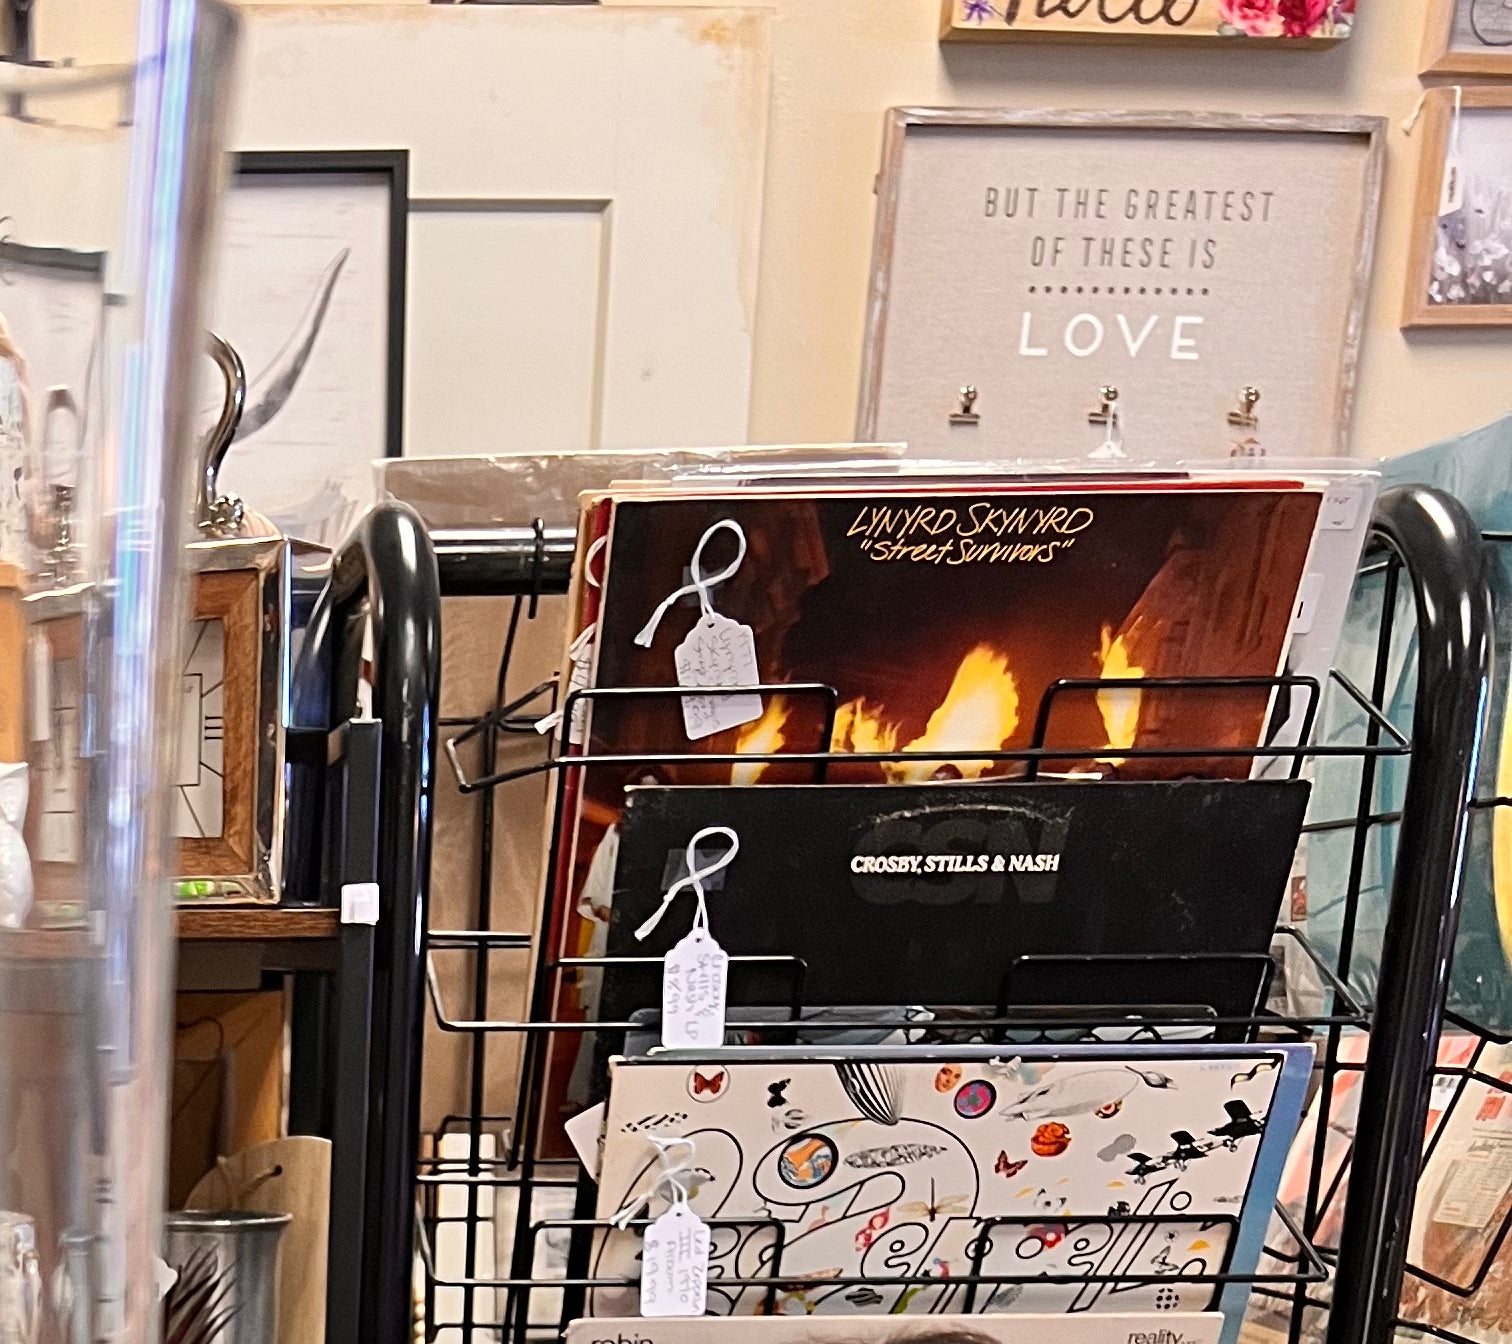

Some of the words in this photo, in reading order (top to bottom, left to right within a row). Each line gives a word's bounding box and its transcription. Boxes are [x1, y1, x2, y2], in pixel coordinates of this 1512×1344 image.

[984, 186, 1038, 218] BUT
[1056, 188, 1109, 220] THE
[1123, 188, 1275, 222] GREATEST
[1030, 236, 1064, 267] OF
[1082, 237, 1173, 269] THESE
[1189, 238, 1218, 270] IS
[1018, 311, 1204, 361] LOVE
[846, 506, 957, 538] LYNYRD
[957, 503, 1094, 536] SKYNYRD
[850, 855, 923, 875] CROSBY,
[924, 854, 989, 872] STILLS
[991, 855, 1005, 872] &
[1008, 854, 1060, 872] NASH
